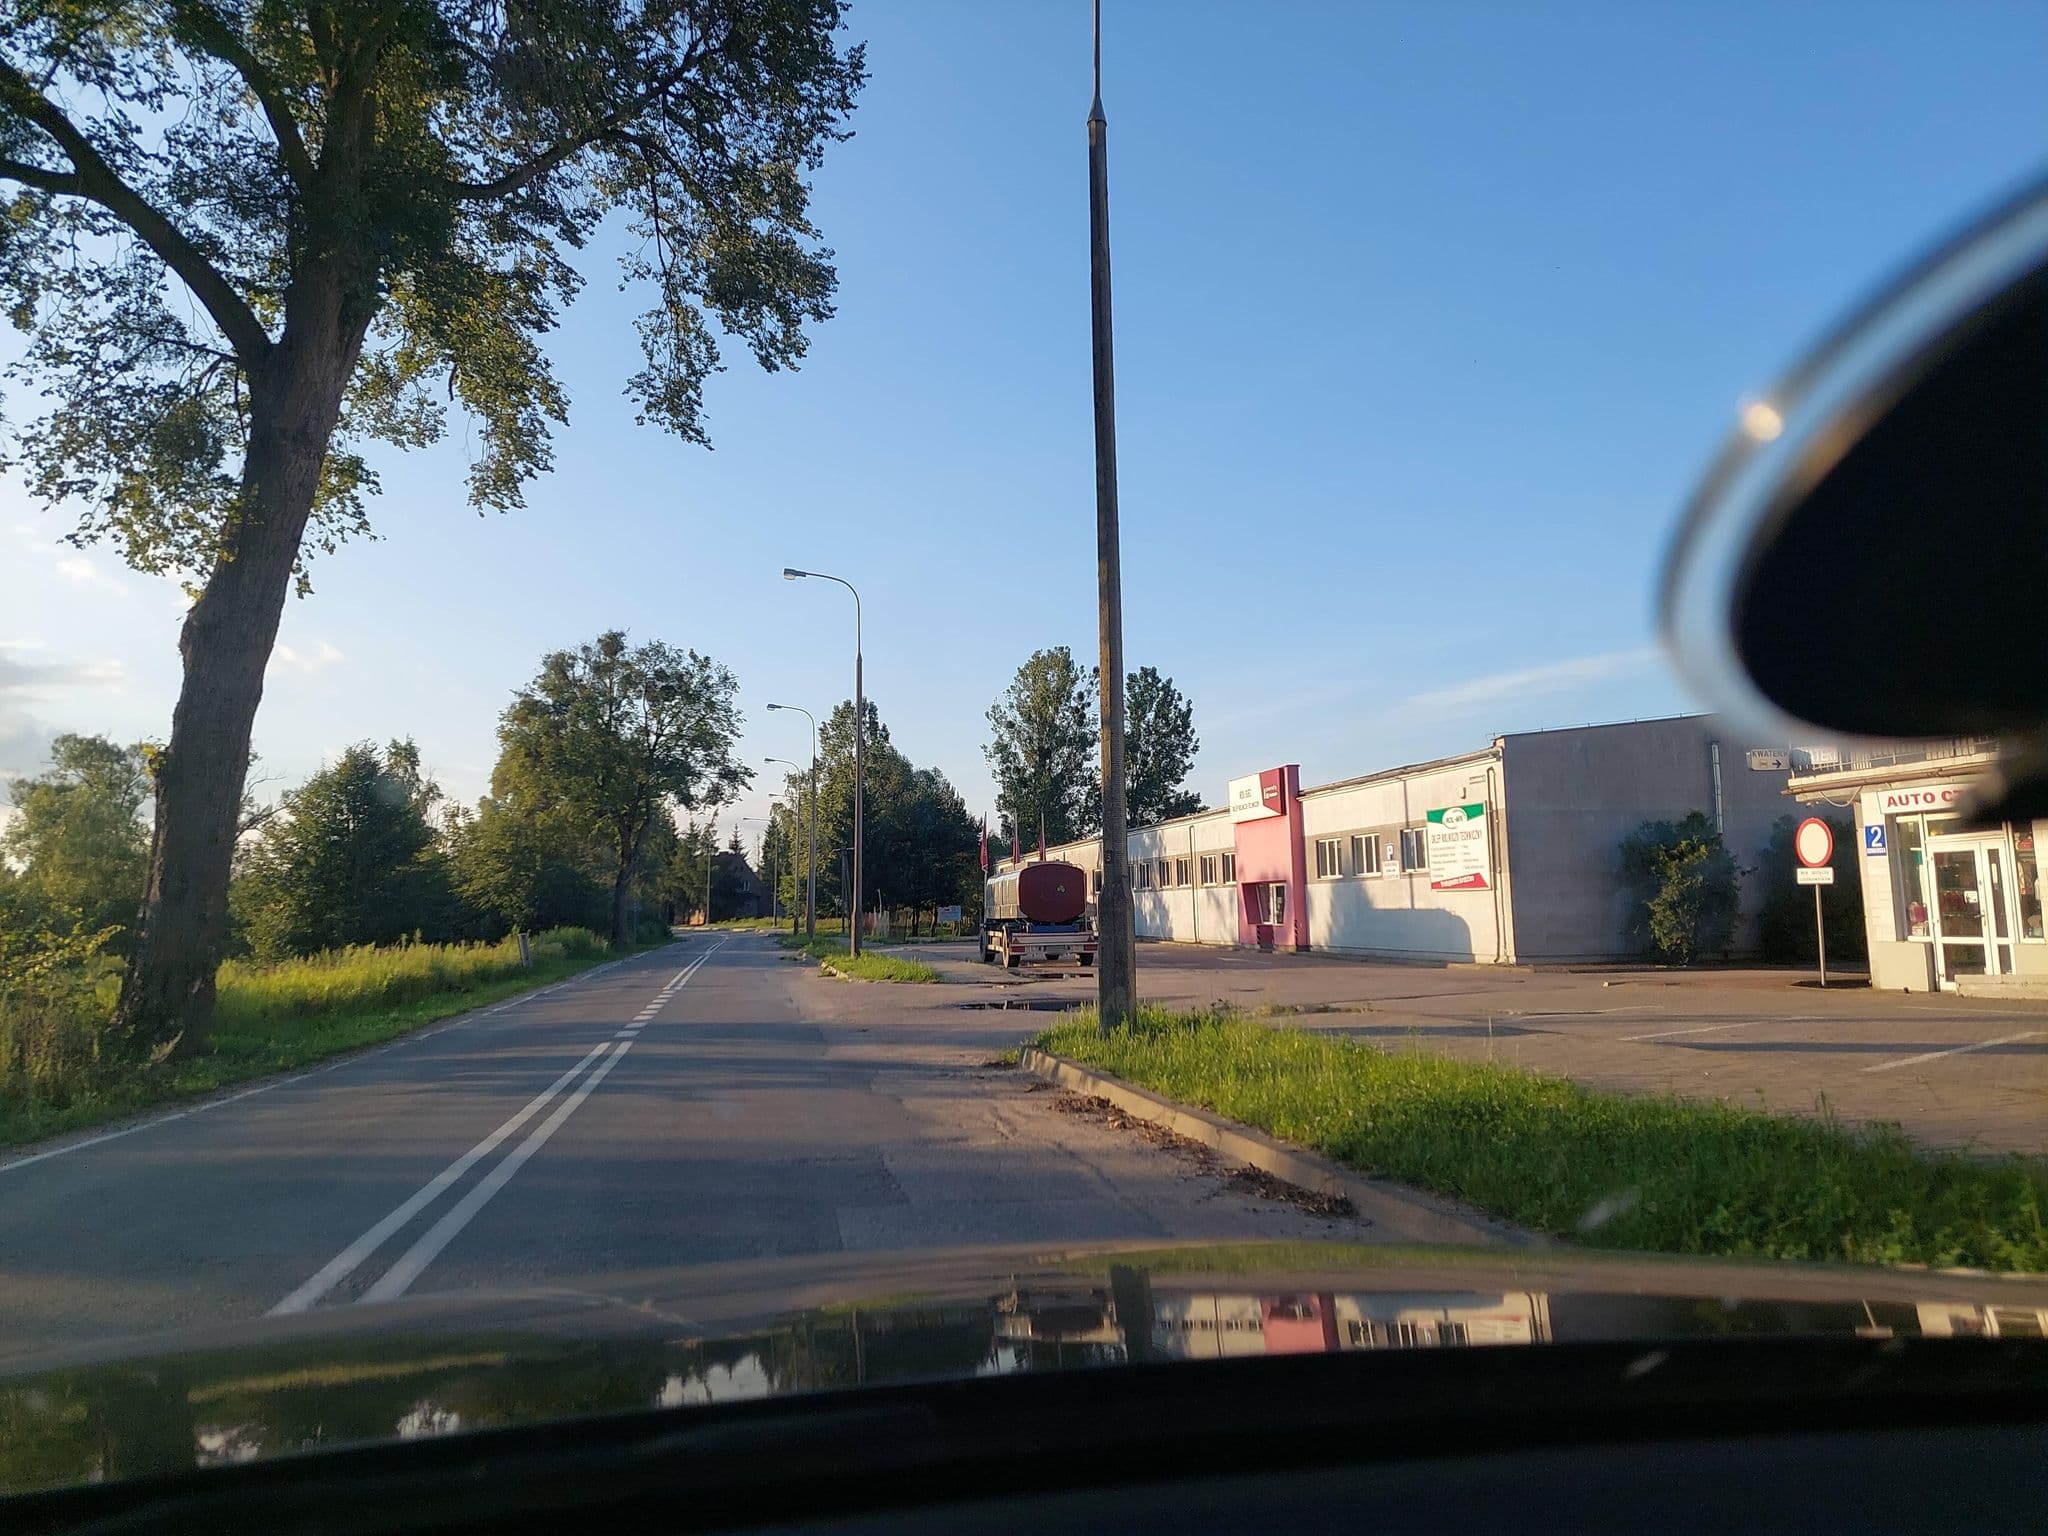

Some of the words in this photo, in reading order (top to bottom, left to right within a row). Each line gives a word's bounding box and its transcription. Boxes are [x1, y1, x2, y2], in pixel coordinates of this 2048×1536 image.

[1887, 792, 1936, 808] AUTO
[1941, 789, 1963, 803] C
[1870, 826, 1883, 847] 2
